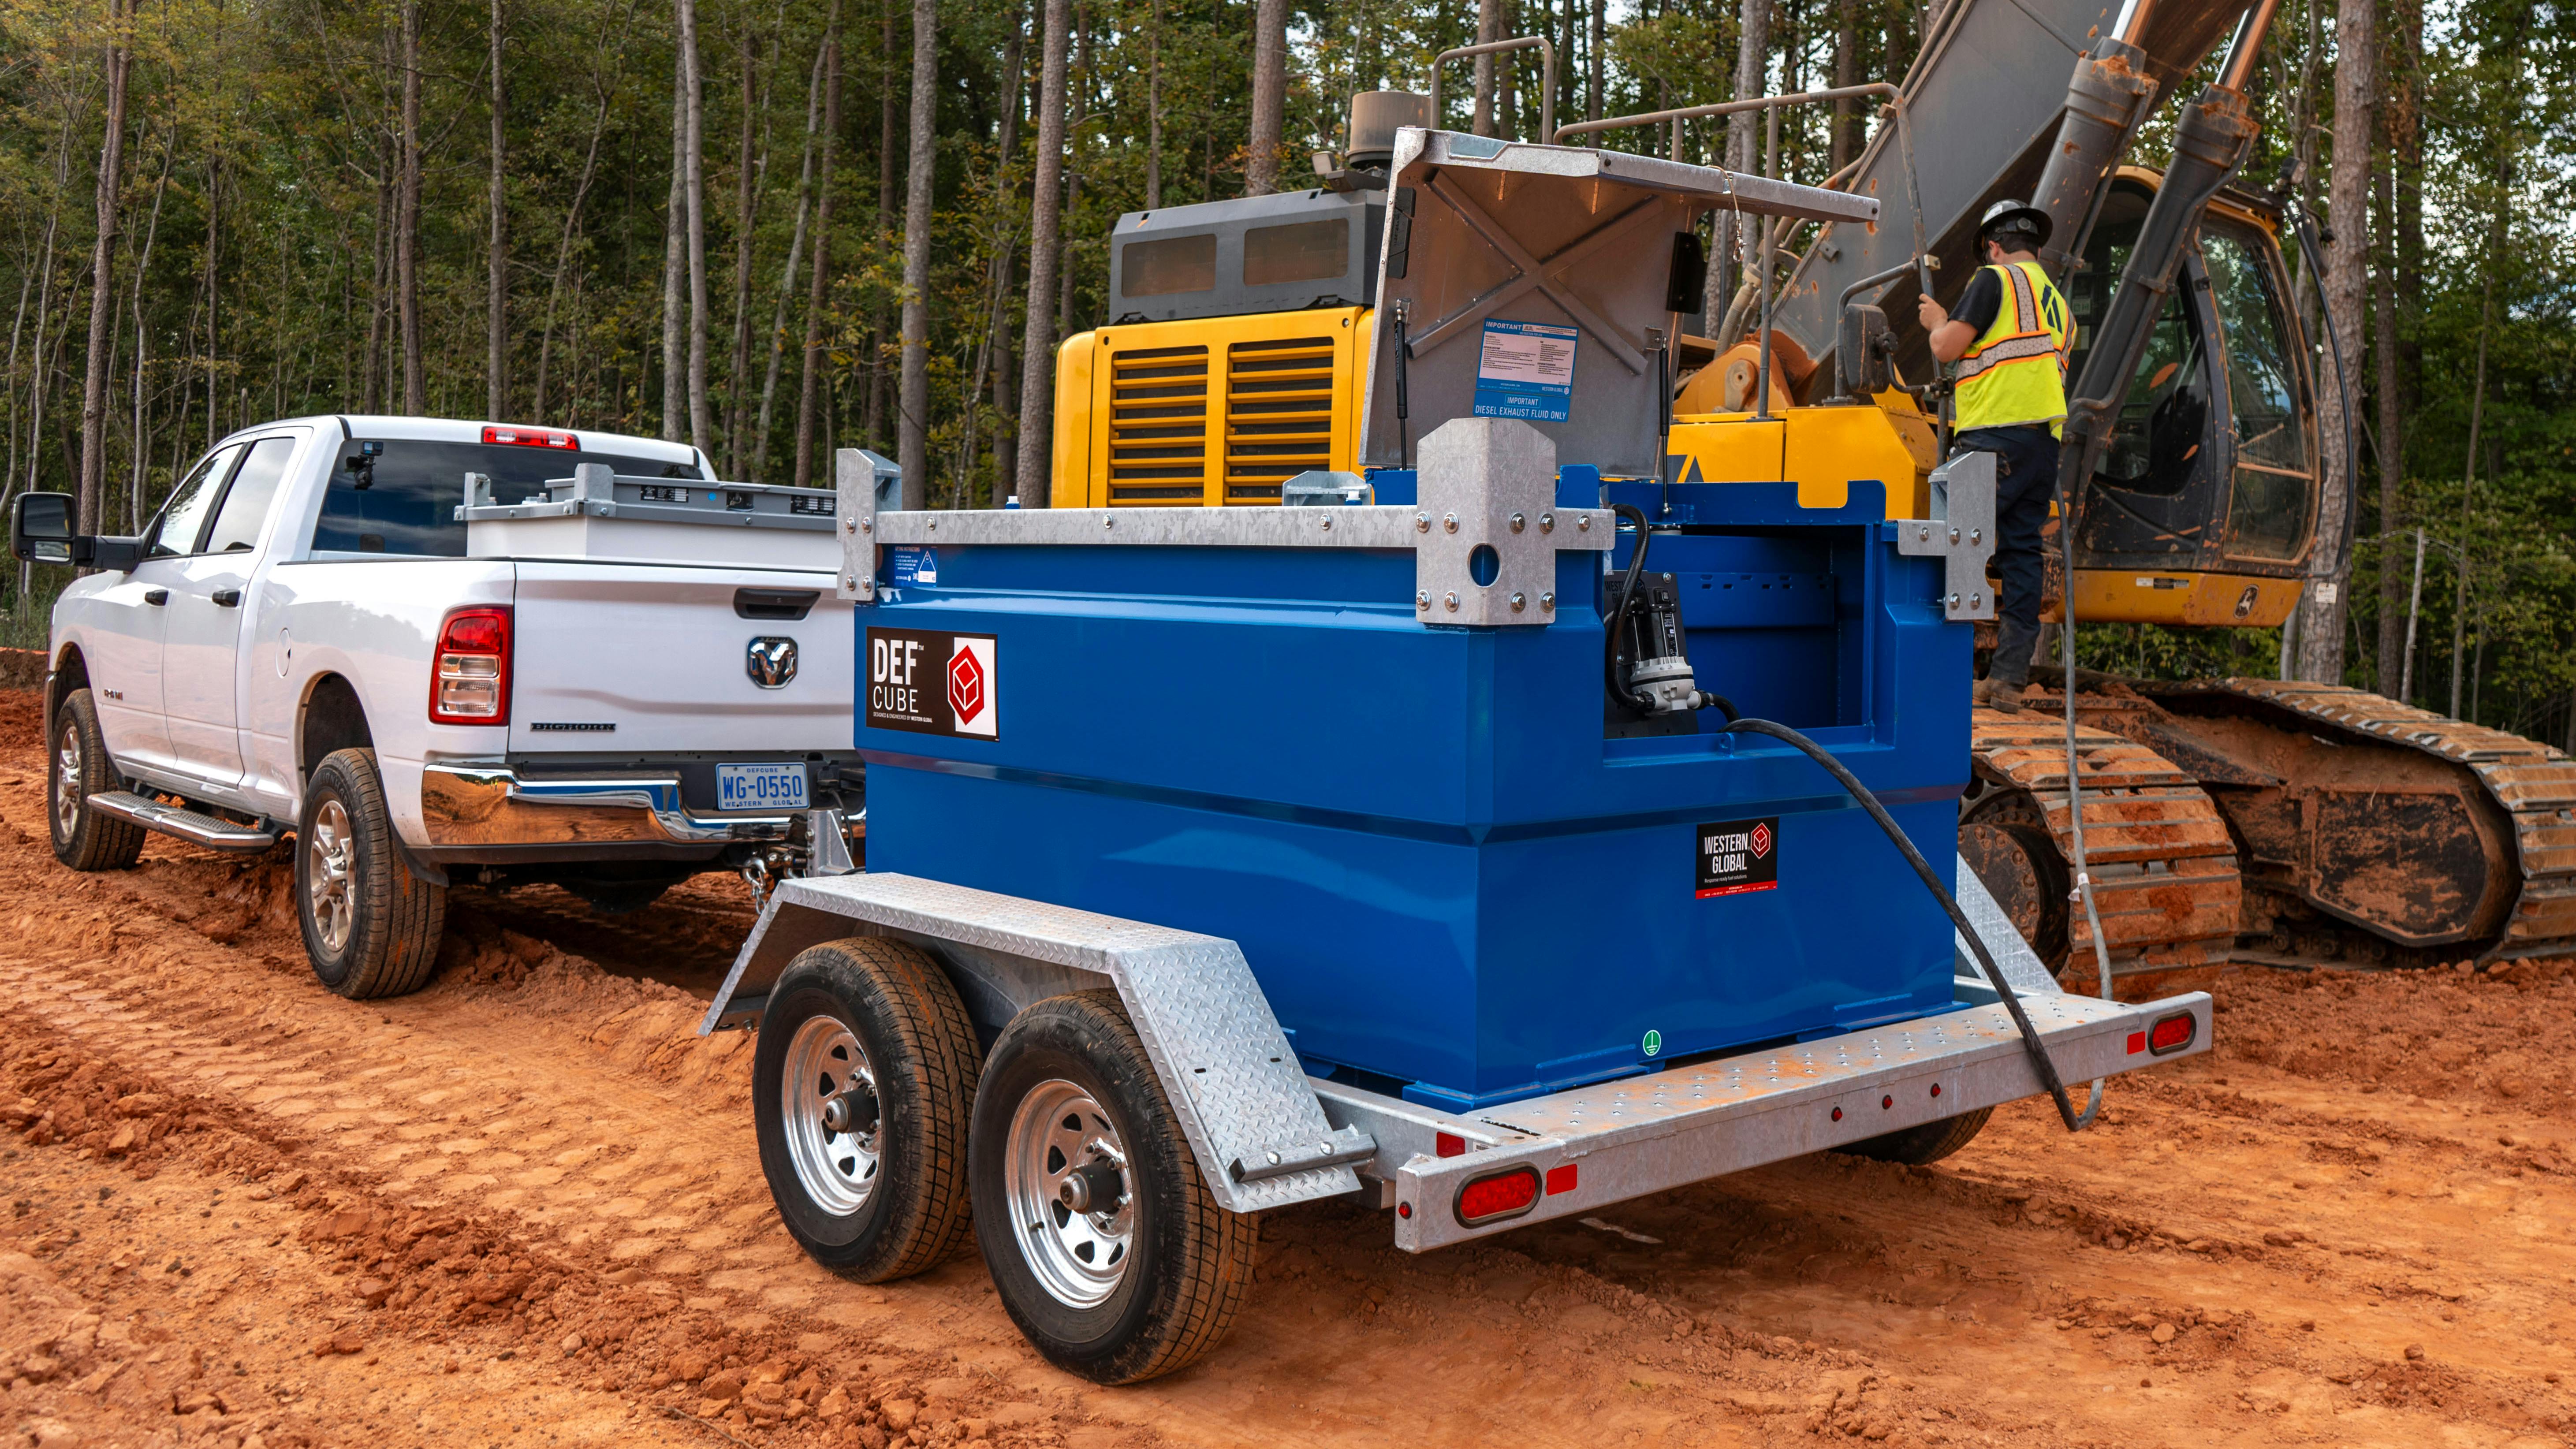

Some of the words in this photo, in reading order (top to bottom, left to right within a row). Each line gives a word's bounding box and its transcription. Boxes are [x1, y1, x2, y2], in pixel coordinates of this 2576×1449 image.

[1486, 321, 1521, 331] IMPORTANT
[1507, 397, 1539, 406] IMPORTANT
[1475, 405, 1497, 415] DIESEL
[1499, 407, 1529, 417] EXHAUST
[1531, 409, 1549, 418] FLUID
[1551, 411, 1566, 420] ONLY
[874, 638, 918, 685] DEF
[873, 685, 918, 713] CUBE
[723, 775, 802, 799] WG-0550
[1704, 833, 1748, 854] WESTERN
[1712, 853, 1747, 874] GLOBAL
